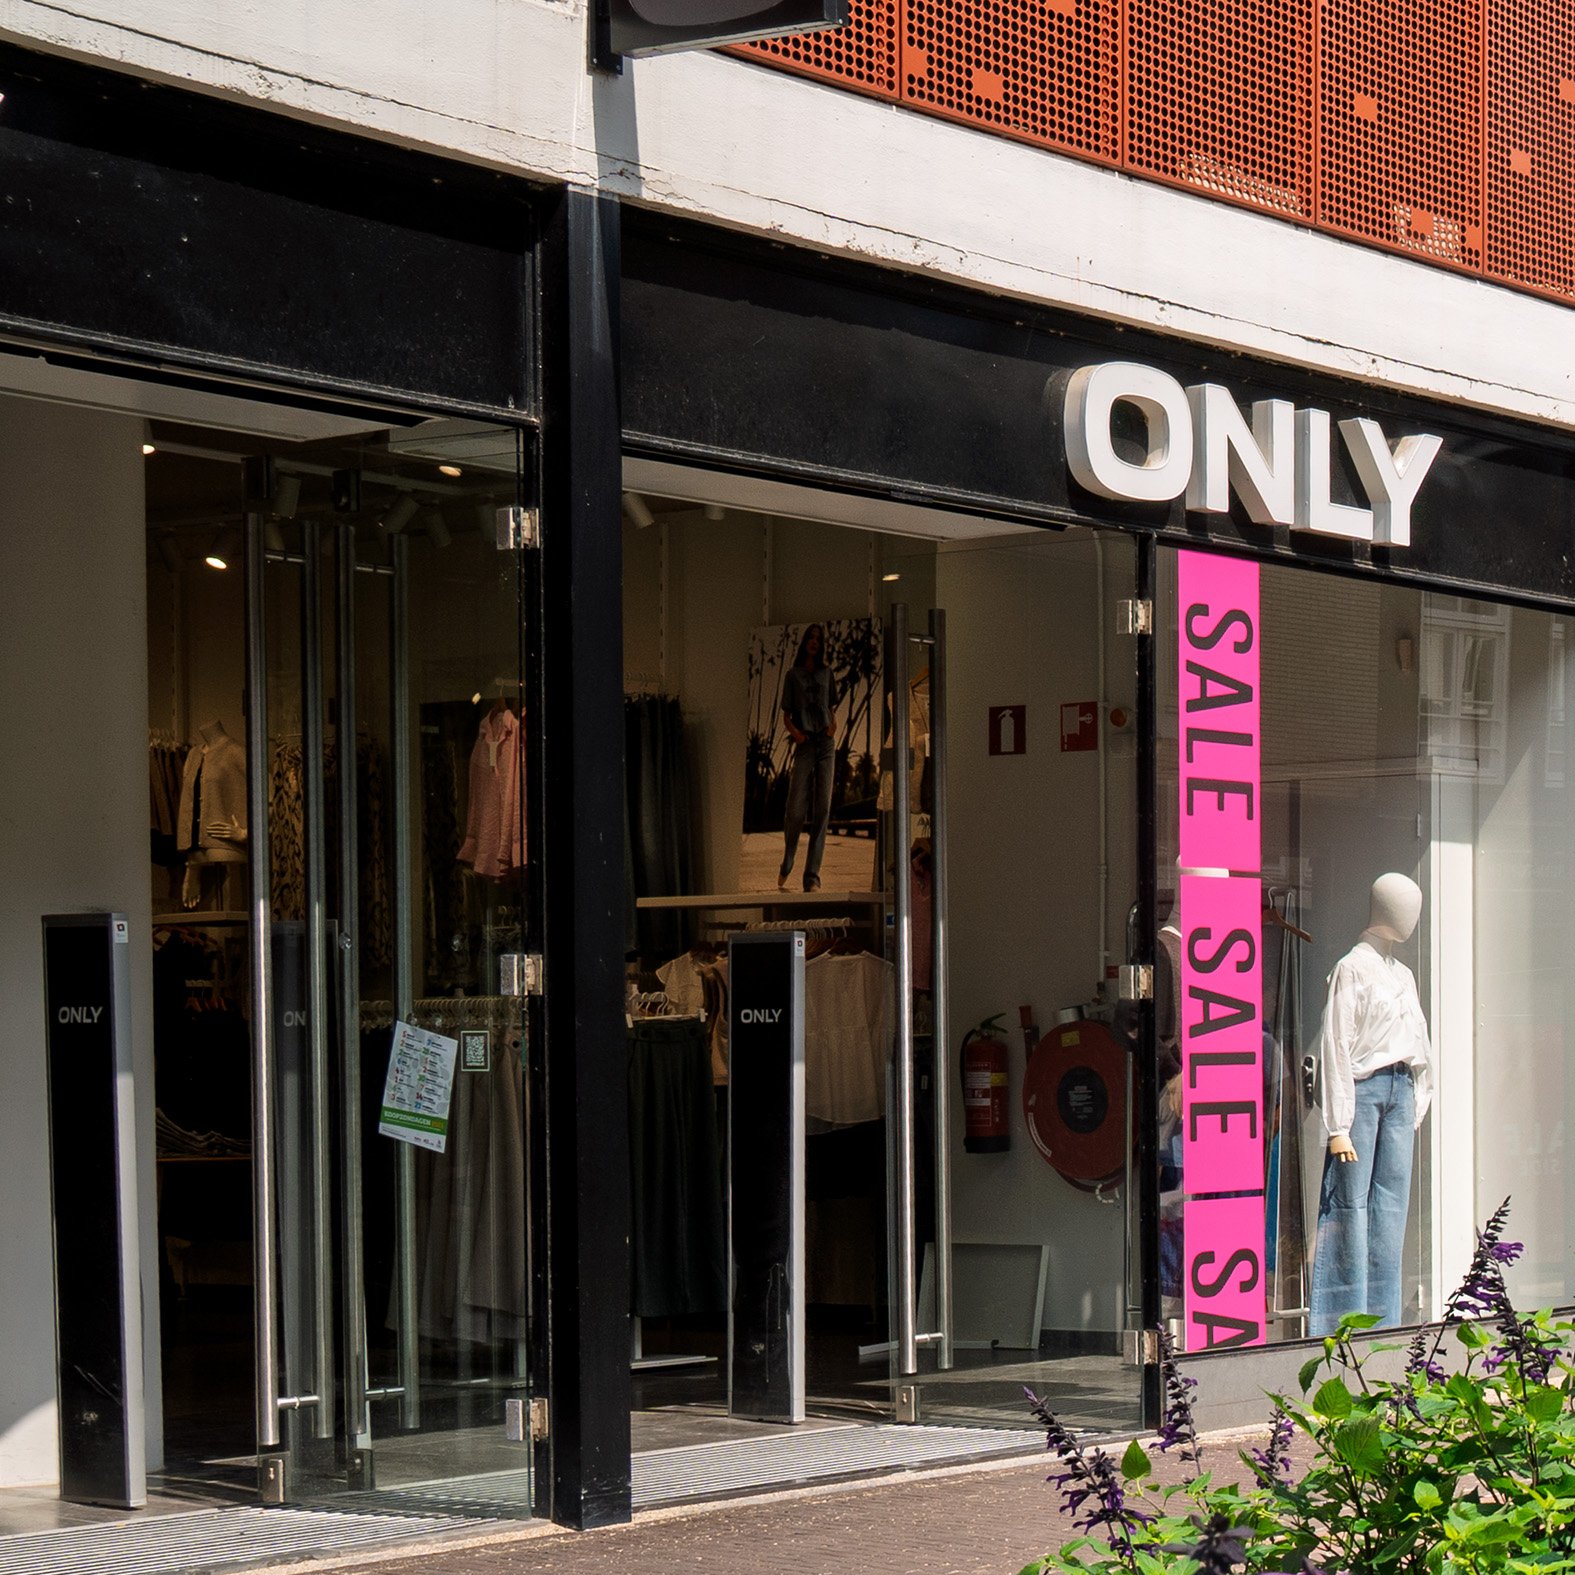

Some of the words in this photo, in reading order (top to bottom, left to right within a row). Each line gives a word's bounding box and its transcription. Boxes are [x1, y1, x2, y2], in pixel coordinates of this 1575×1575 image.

[1064, 361, 1443, 547] ONLY
[1186, 602, 1255, 821] SALE
[58, 1006, 102, 1024] ONLY
[284, 1011, 307, 1027] ON
[741, 1008, 782, 1024] ONLY
[1187, 927, 1258, 1144] SALE
[1191, 1247, 1262, 1346] SA
